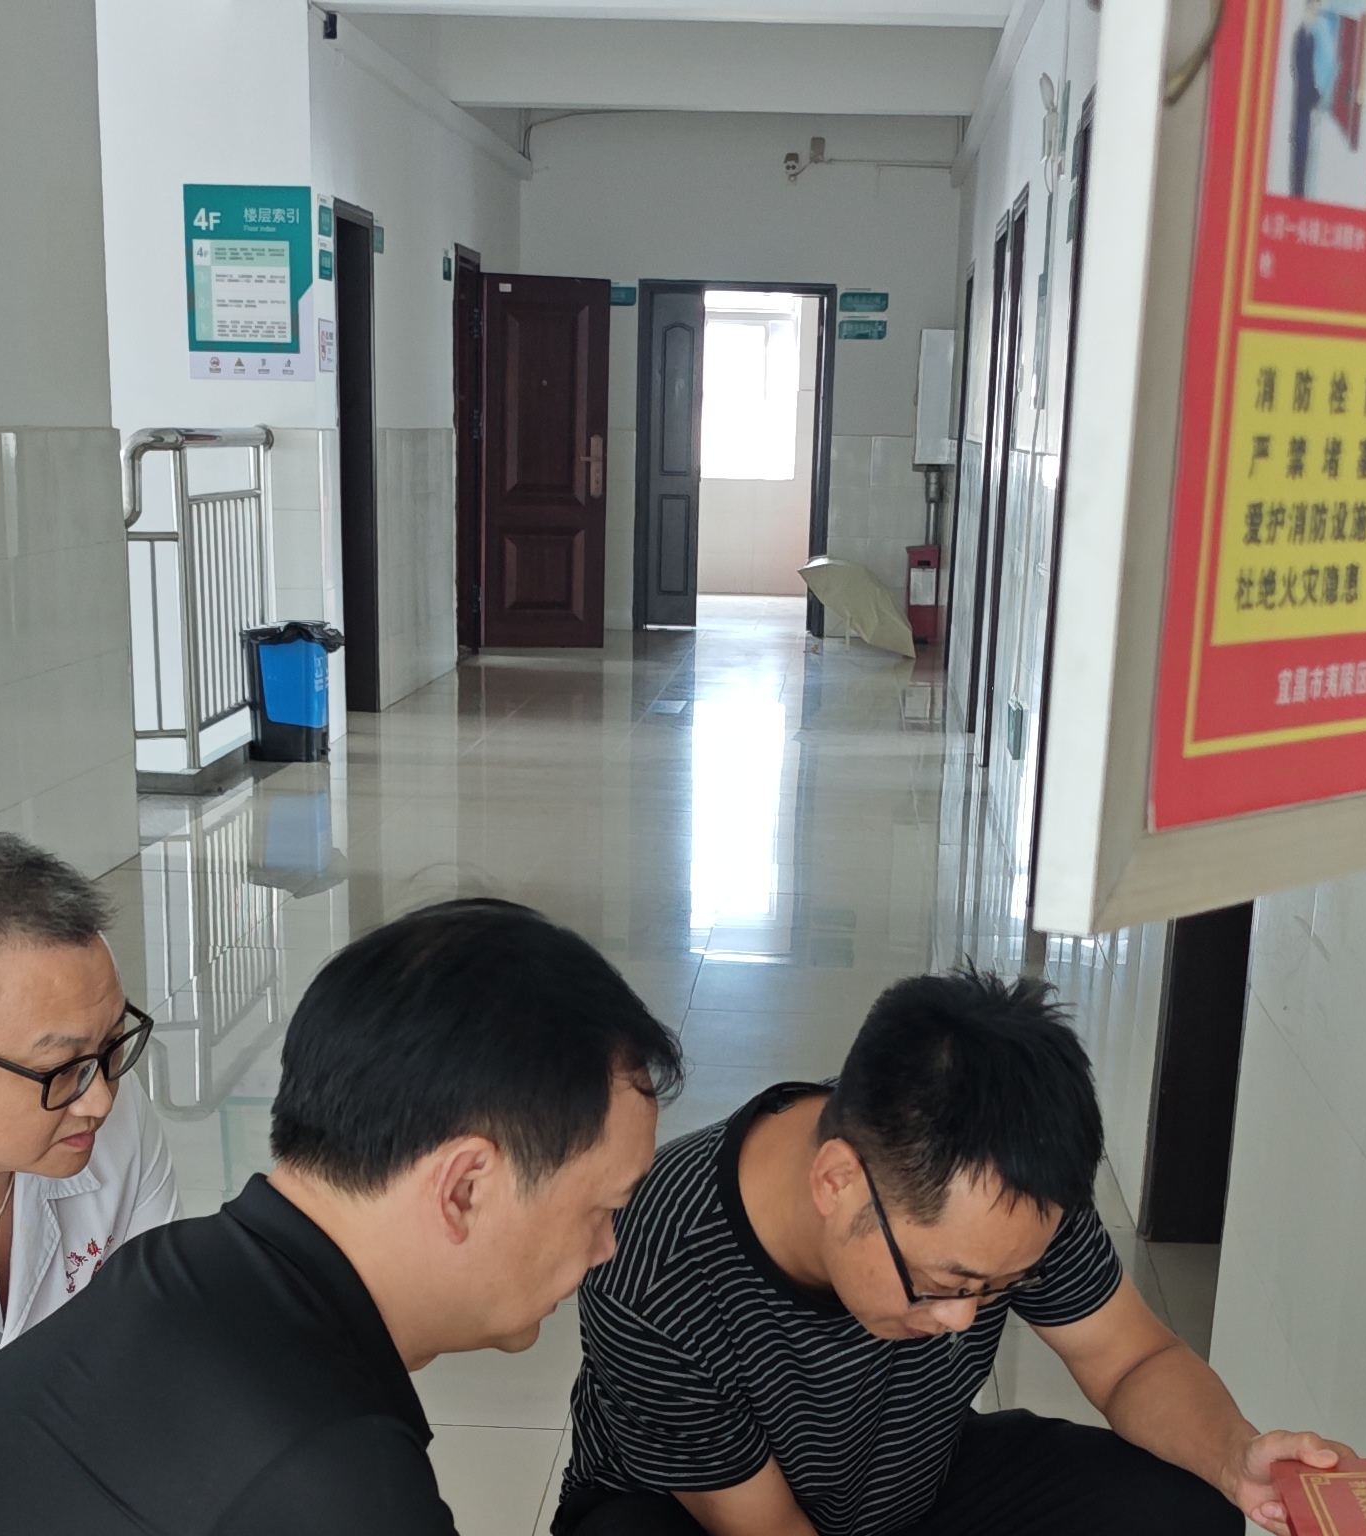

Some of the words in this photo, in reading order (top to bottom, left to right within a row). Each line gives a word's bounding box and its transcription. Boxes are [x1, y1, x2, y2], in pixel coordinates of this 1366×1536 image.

[193, 207, 222, 231] 4F
[243, 207, 300, 224] 楼层索引
[1236, 563, 1361, 612] 杜绝火灾隐患
